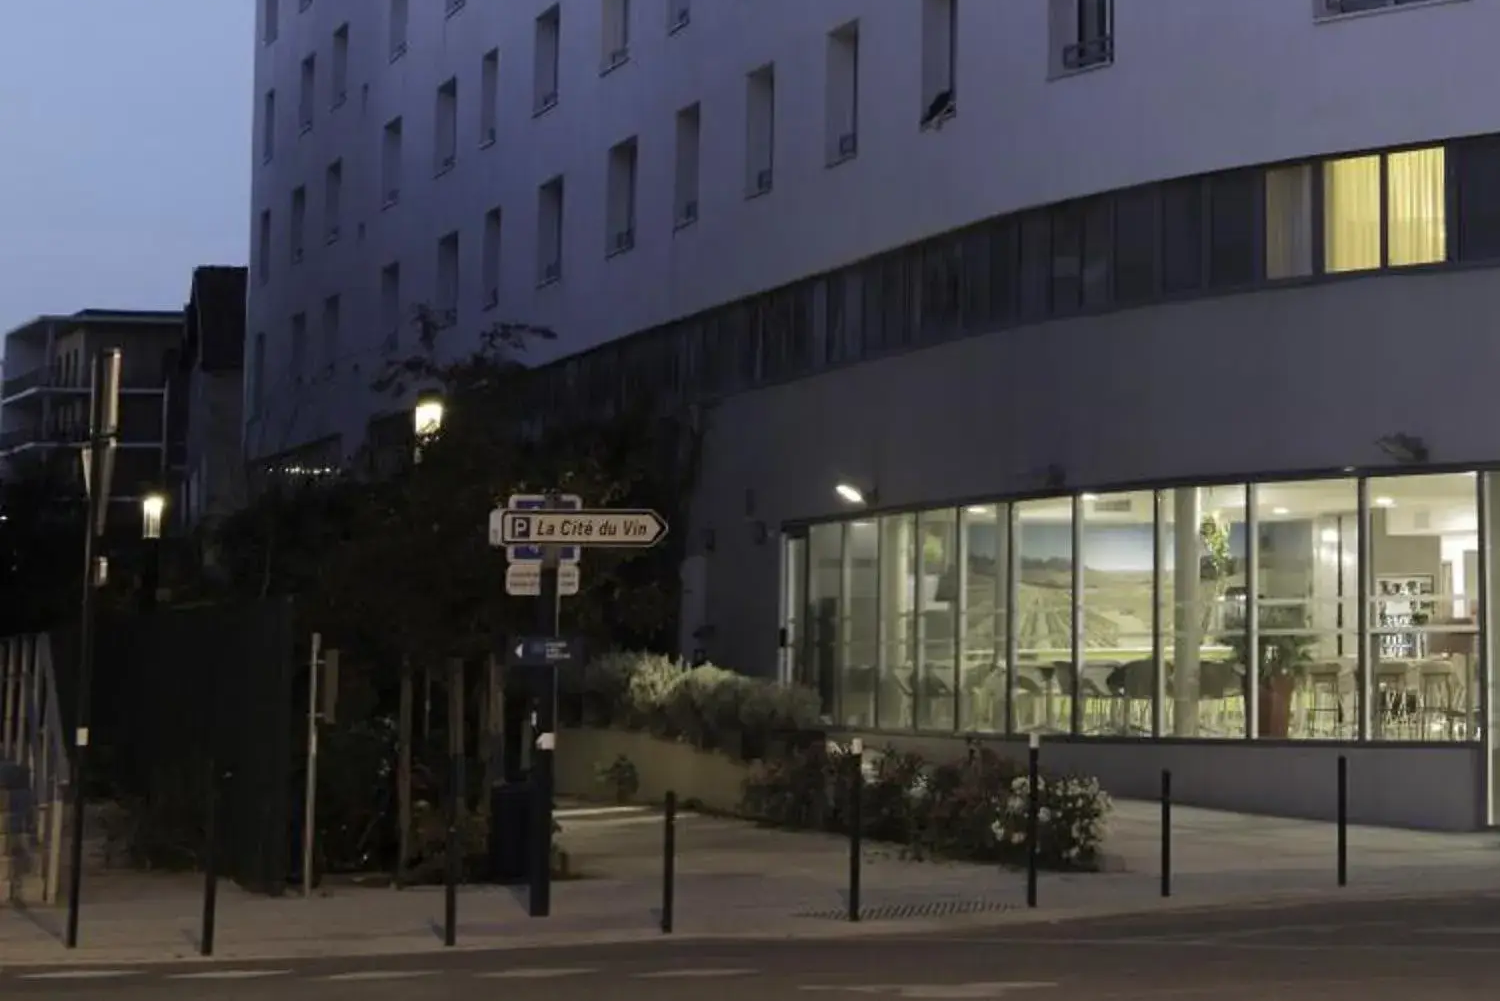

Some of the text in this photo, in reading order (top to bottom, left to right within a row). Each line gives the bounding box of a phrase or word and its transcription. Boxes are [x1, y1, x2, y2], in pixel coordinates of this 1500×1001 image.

[536, 520, 554, 536] La
[560, 519, 594, 536] Cité
[599, 520, 617, 536] du
[623, 519, 647, 536] Vin
